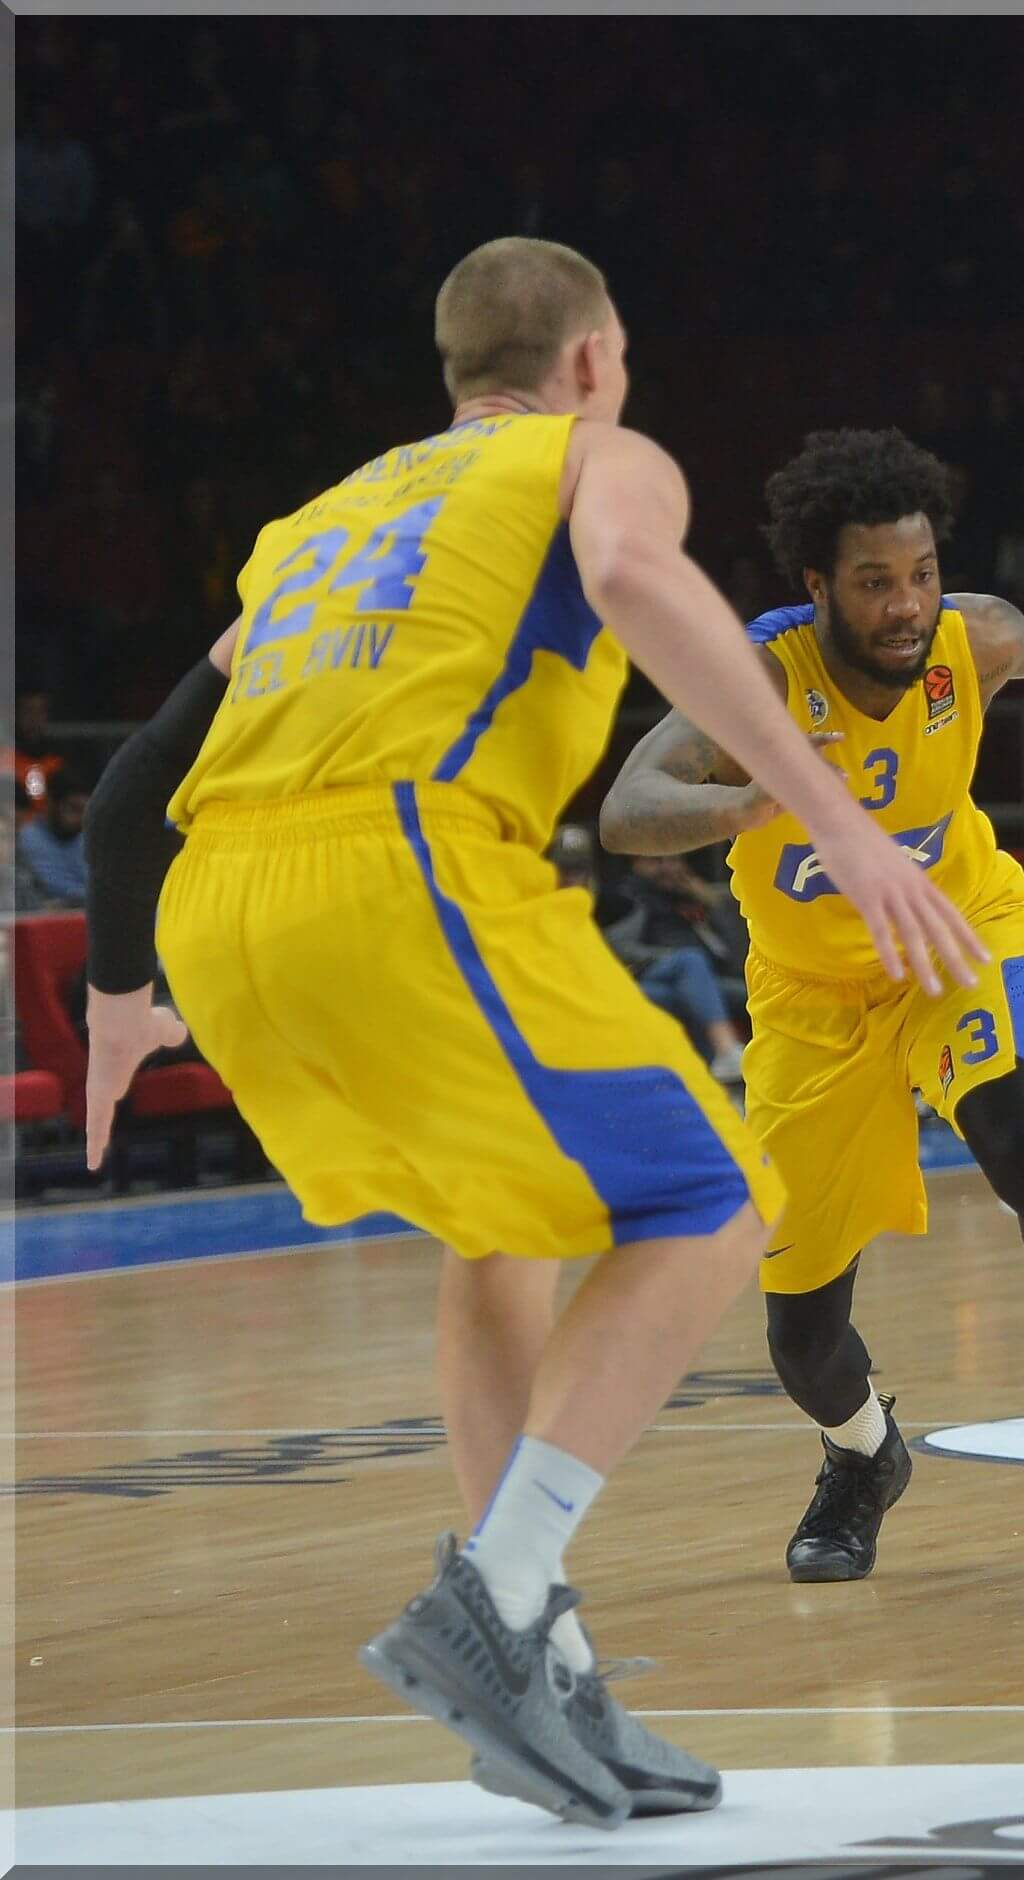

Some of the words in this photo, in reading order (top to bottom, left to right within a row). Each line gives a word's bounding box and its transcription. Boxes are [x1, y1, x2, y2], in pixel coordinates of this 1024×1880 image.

[244, 495, 448, 659] 24
[302, 623, 396, 671] AVIV
[859, 747, 899, 810] 3
[956, 1008, 999, 1065] 3
